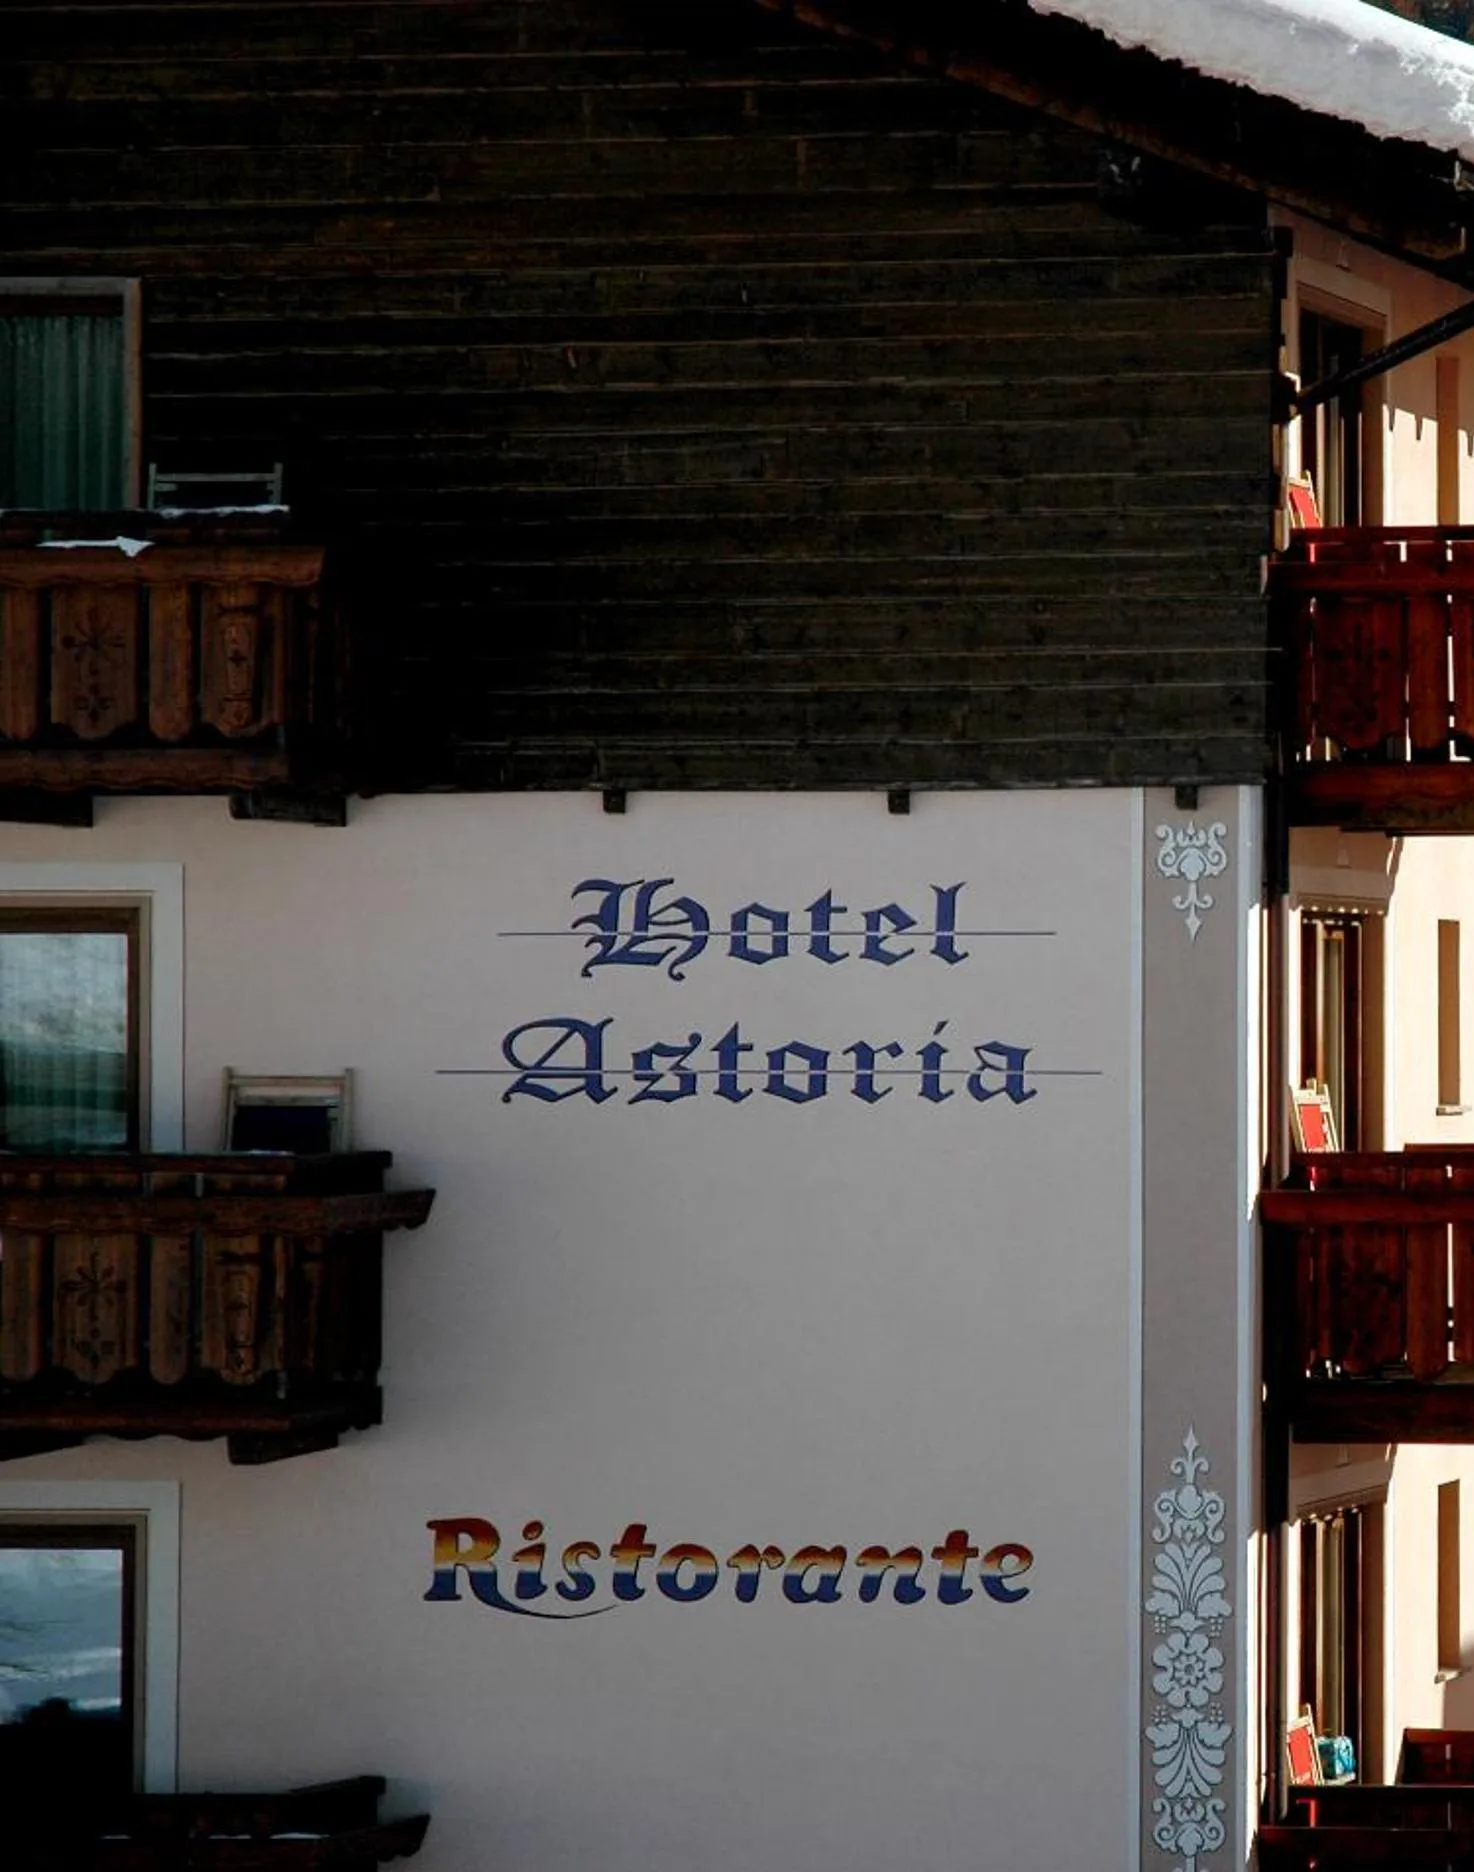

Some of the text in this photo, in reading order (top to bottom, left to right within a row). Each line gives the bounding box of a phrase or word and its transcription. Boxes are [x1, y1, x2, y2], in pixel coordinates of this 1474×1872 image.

[571, 877, 970, 981] Hotel
[501, 1017, 1038, 1105] Astoria
[423, 1517, 1034, 1620] Ristorante
